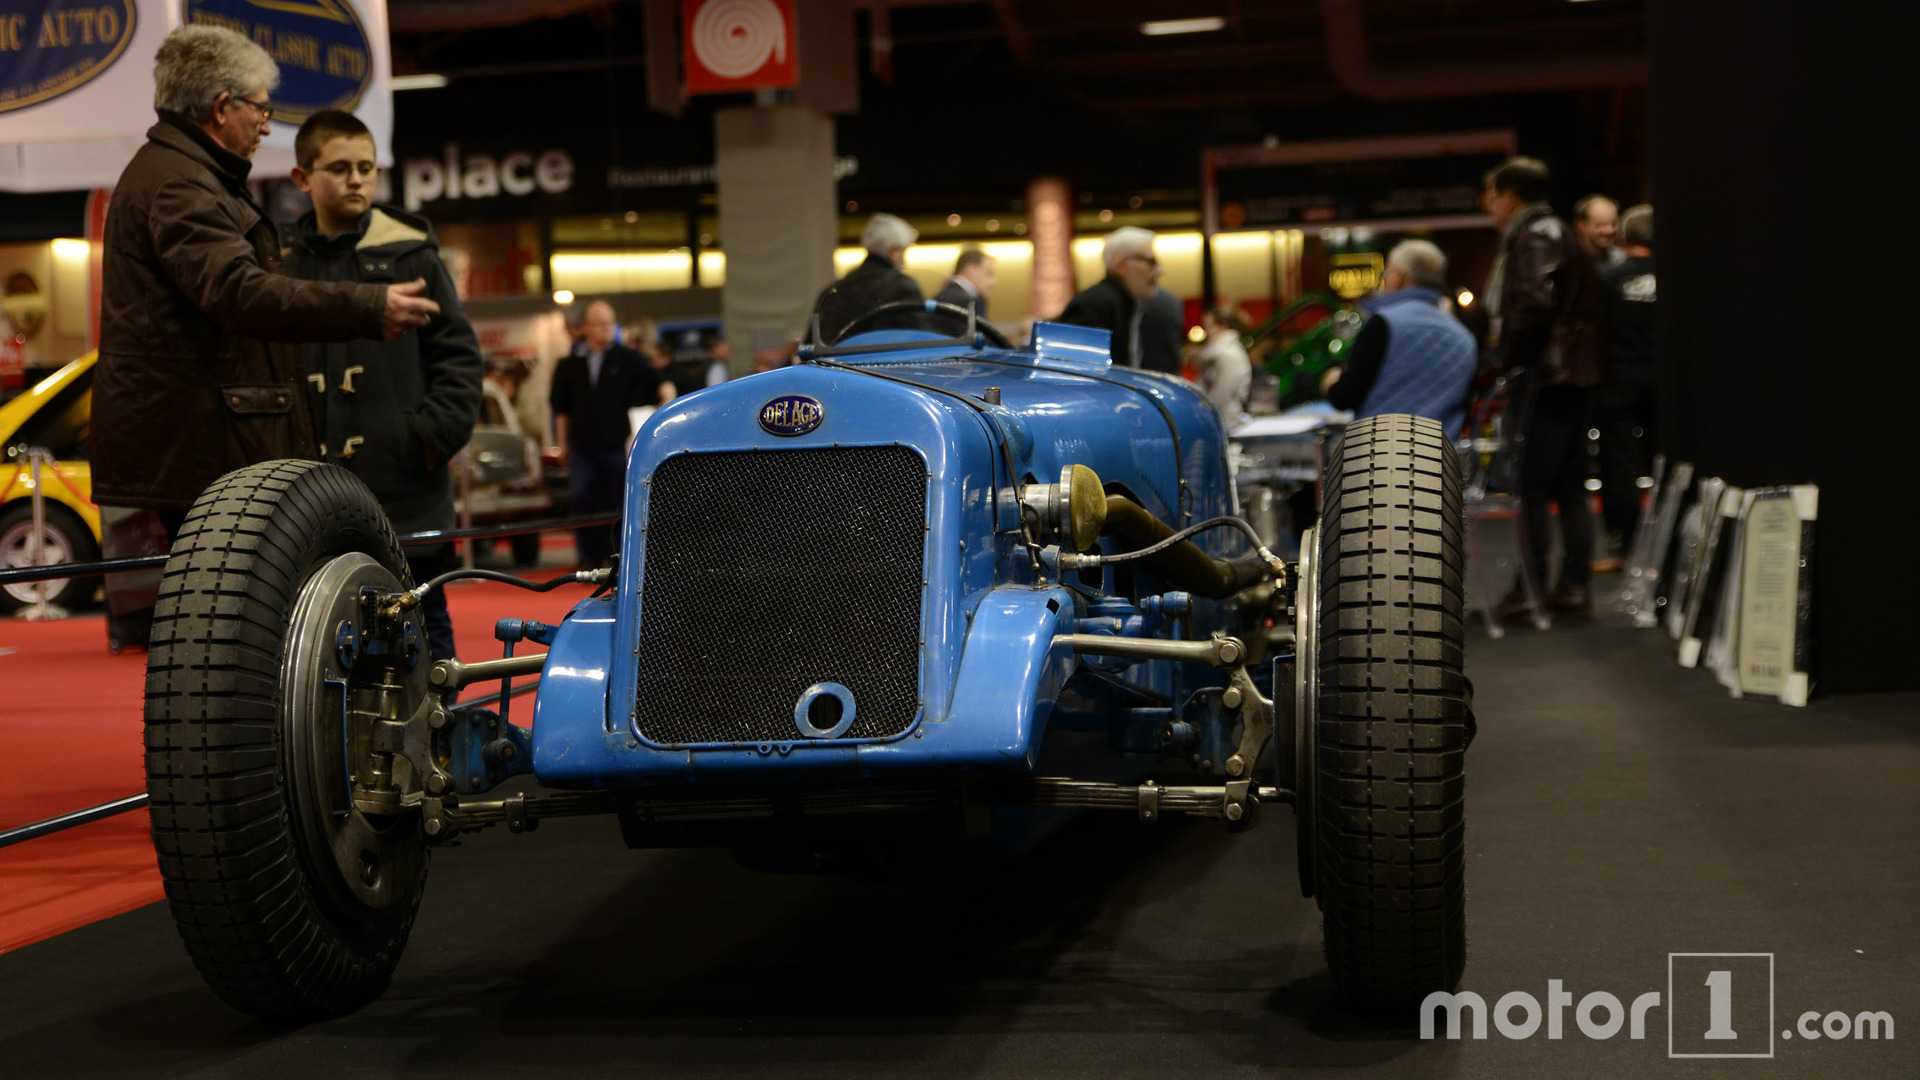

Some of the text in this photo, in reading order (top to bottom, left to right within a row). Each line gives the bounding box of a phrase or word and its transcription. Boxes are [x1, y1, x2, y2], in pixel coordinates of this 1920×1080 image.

[38, 6, 119, 48] AUTO
[325, 42, 369, 82] AUTO
[403, 143, 573, 213] place
[607, 164, 718, 188] Restauran
[765, 400, 818, 427] DELAGE
